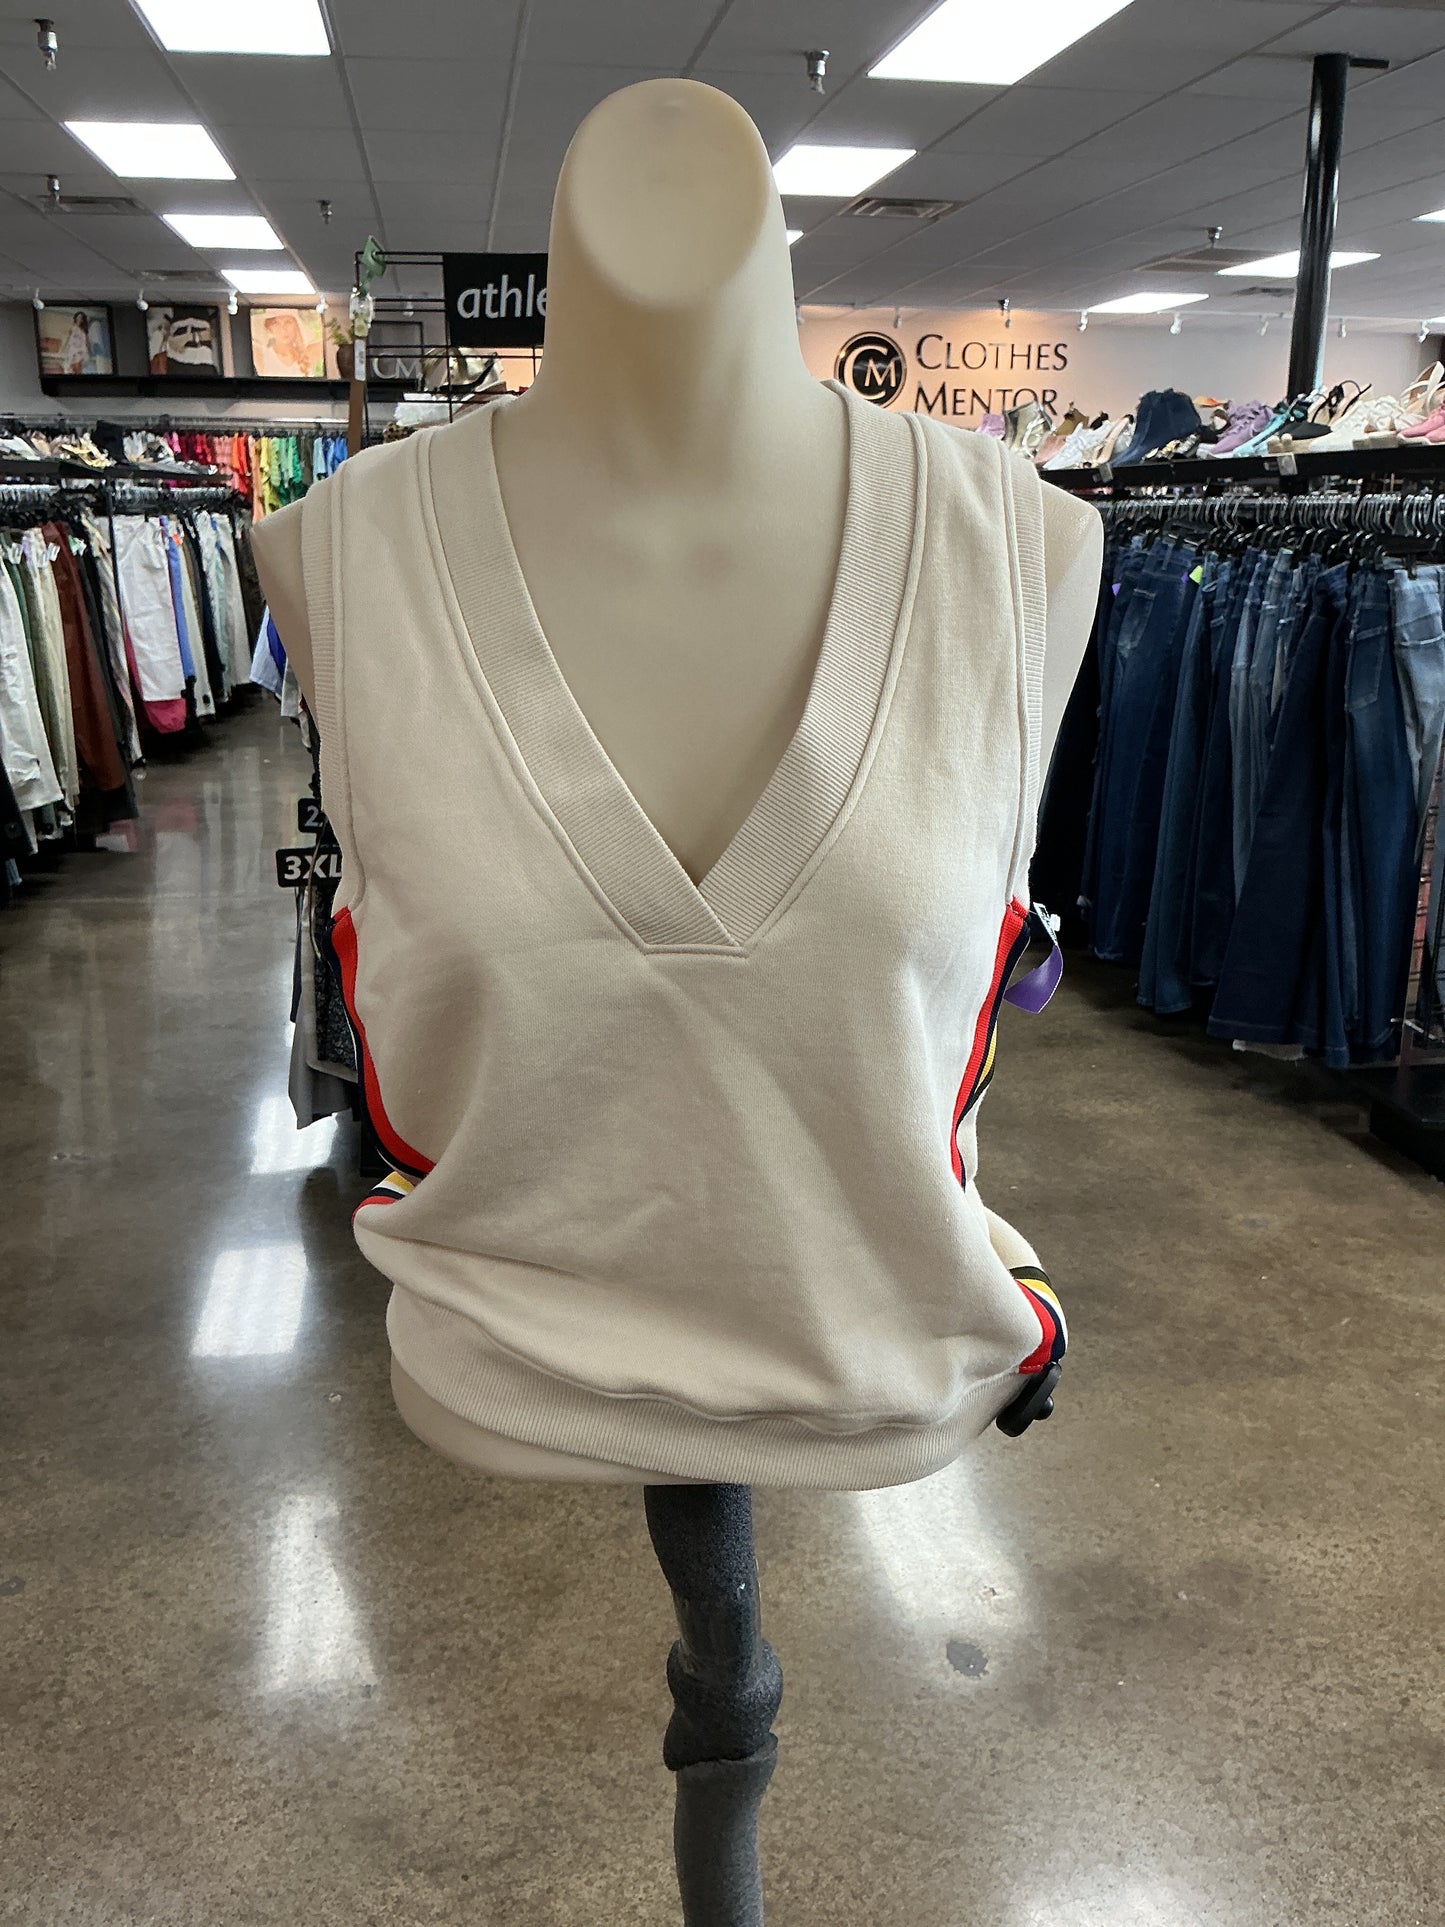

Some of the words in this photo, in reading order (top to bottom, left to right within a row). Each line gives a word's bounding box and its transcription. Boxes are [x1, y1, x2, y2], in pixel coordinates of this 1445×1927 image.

[916, 333, 1069, 371] CLOTHES
[914, 380, 1058, 416] MENTOR
[284, 853, 342, 880] 3XL
